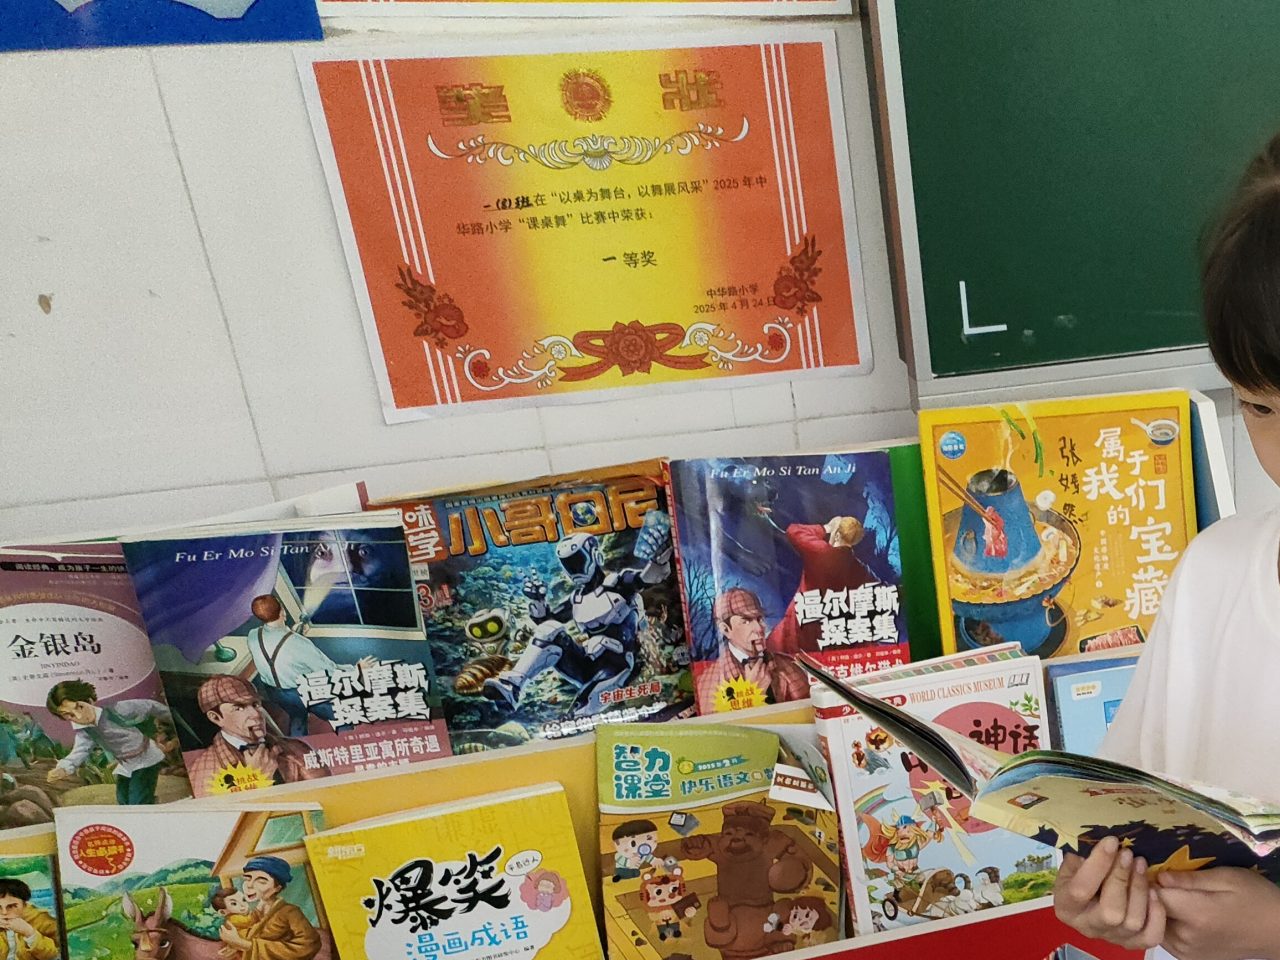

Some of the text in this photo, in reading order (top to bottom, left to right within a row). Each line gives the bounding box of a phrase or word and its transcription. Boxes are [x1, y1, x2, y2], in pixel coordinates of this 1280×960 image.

[602, 250, 657, 268] 一等奖
[706, 283, 760, 299] 中华路小学
[710, 463, 856, 479] Fu Er Mo Si Tan An Ji
[448, 486, 658, 557] 小哥白尼
[175, 552, 197, 563] Fu
[203, 551, 223, 561] Er
[229, 548, 254, 559] Mo
[260, 546, 275, 557] Si
[282, 544, 310, 555] Tan
[794, 581, 900, 626] 福尔摩斯
[817, 612, 898, 650] 探案集
[7, 632, 101, 659] 金银岛
[296, 660, 429, 708] 福尔摩斯
[600, 681, 662, 704] 宇宙生死局
[910, 677, 1005, 704] WORLD CLASSICS MUSEUM
[328, 689, 430, 735] 探案集
[968, 718, 1040, 755] 神话
[303, 734, 441, 770] 威斯特里亚寓所奇遇
[614, 744, 671, 773] 智力
[614, 773, 671, 800] 课堂
[680, 771, 750, 795] 快乐语文
[362, 846, 512, 934] 爆笑
